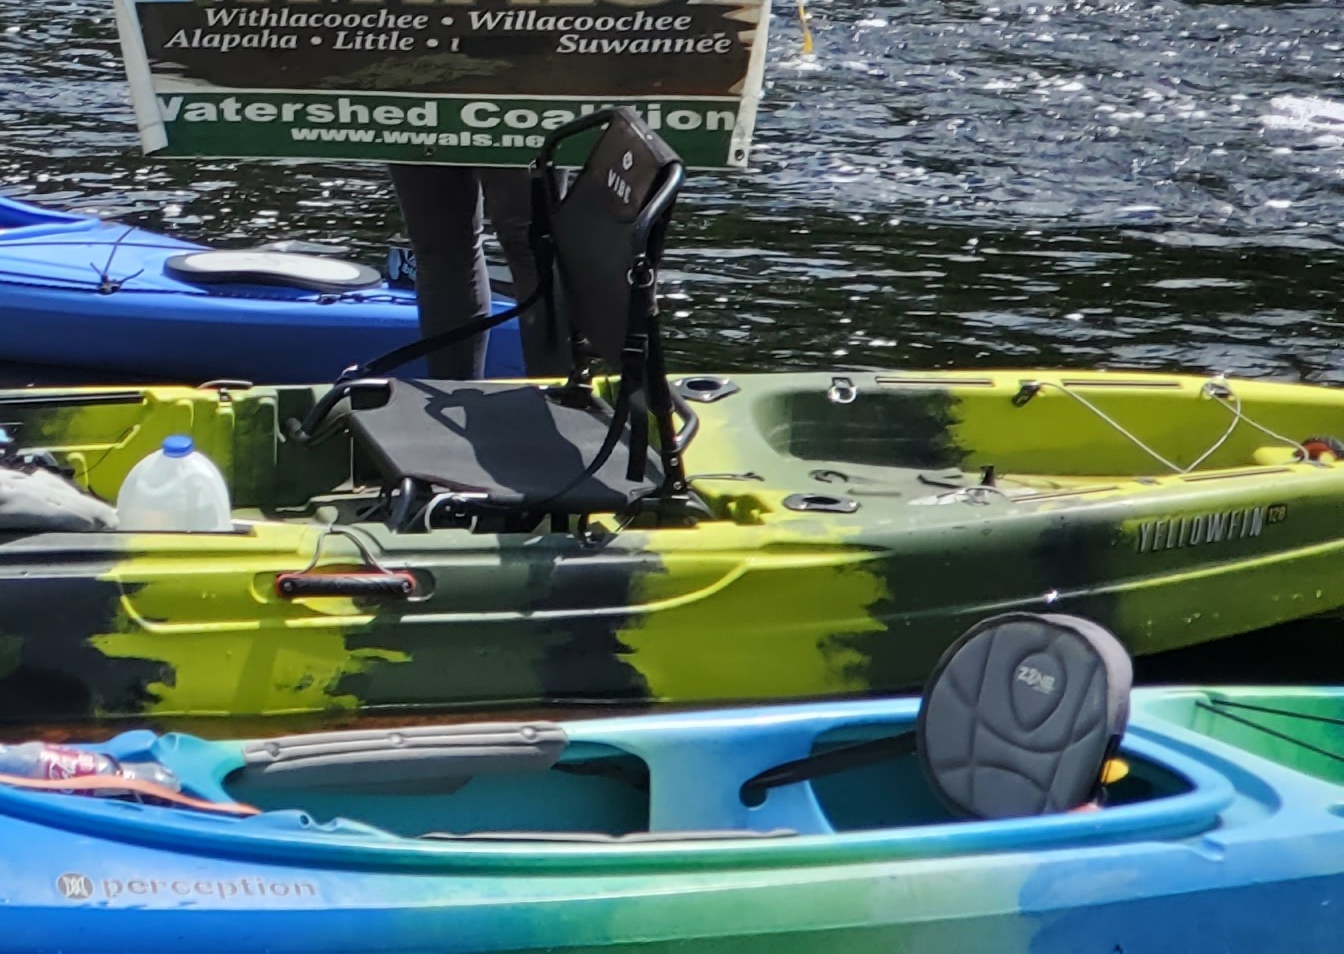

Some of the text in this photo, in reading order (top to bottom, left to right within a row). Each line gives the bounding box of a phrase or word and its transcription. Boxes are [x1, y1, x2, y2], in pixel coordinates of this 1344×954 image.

[204, 7, 693, 32] Withlacoochee Willacoochee
[163, 28, 732, 56] Alapaha Little Suwannee
[460, 101, 737, 133] Coaion
[290, 127, 546, 149] www.wwals.ne
[1138, 506, 1264, 553] YELLOWFIN
[102, 875, 317, 900] perception
